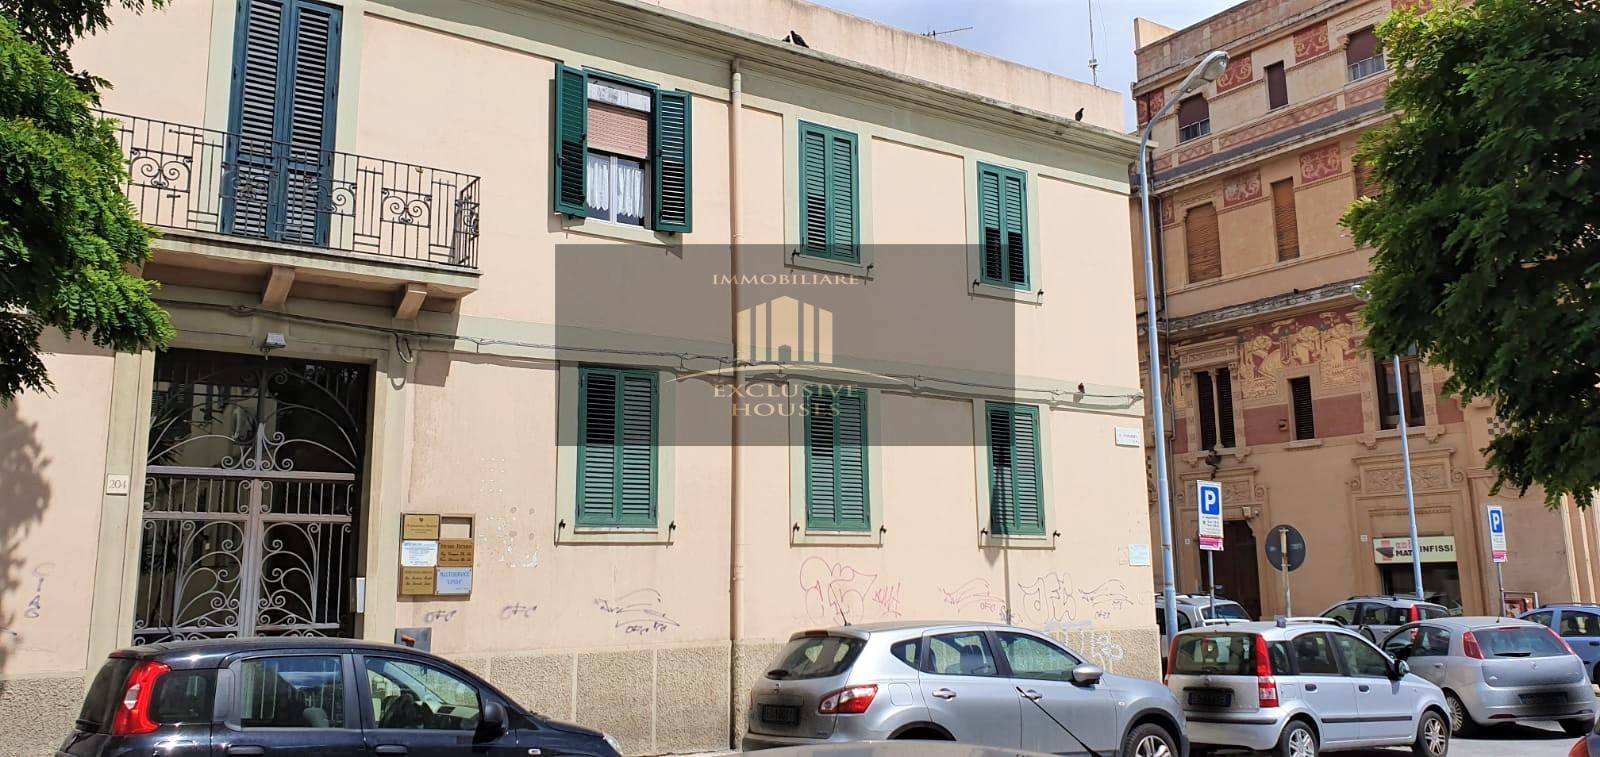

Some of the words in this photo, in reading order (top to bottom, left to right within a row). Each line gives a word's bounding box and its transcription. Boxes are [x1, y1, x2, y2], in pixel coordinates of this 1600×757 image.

[1205, 490, 1216, 511] P
[1493, 512, 1501, 531] P
[1420, 544, 1454, 553] INFISSI
